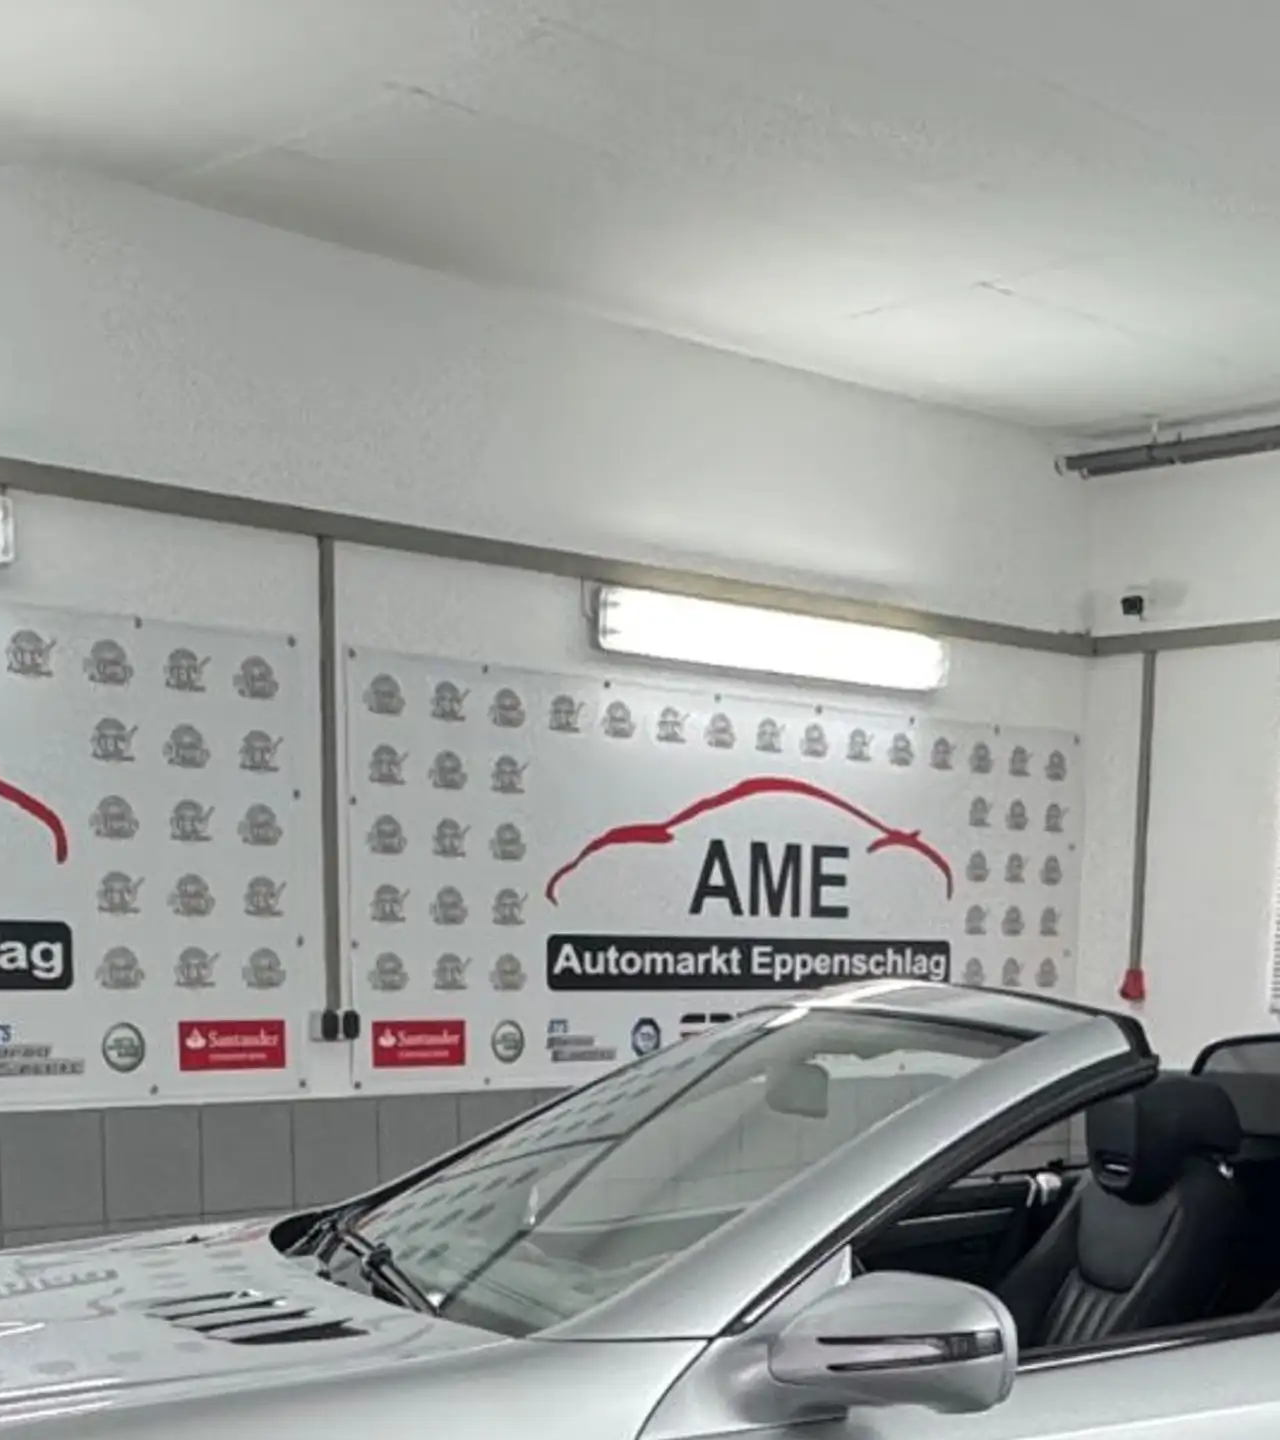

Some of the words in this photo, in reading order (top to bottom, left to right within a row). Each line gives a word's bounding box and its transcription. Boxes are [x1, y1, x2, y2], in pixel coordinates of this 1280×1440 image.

[688, 838, 850, 919] AME
[553, 943, 742, 976] Automarkt
[751, 947, 946, 982] Eppenschlag
[208, 1029, 279, 1048] Santander
[397, 1029, 461, 1048] Santander
